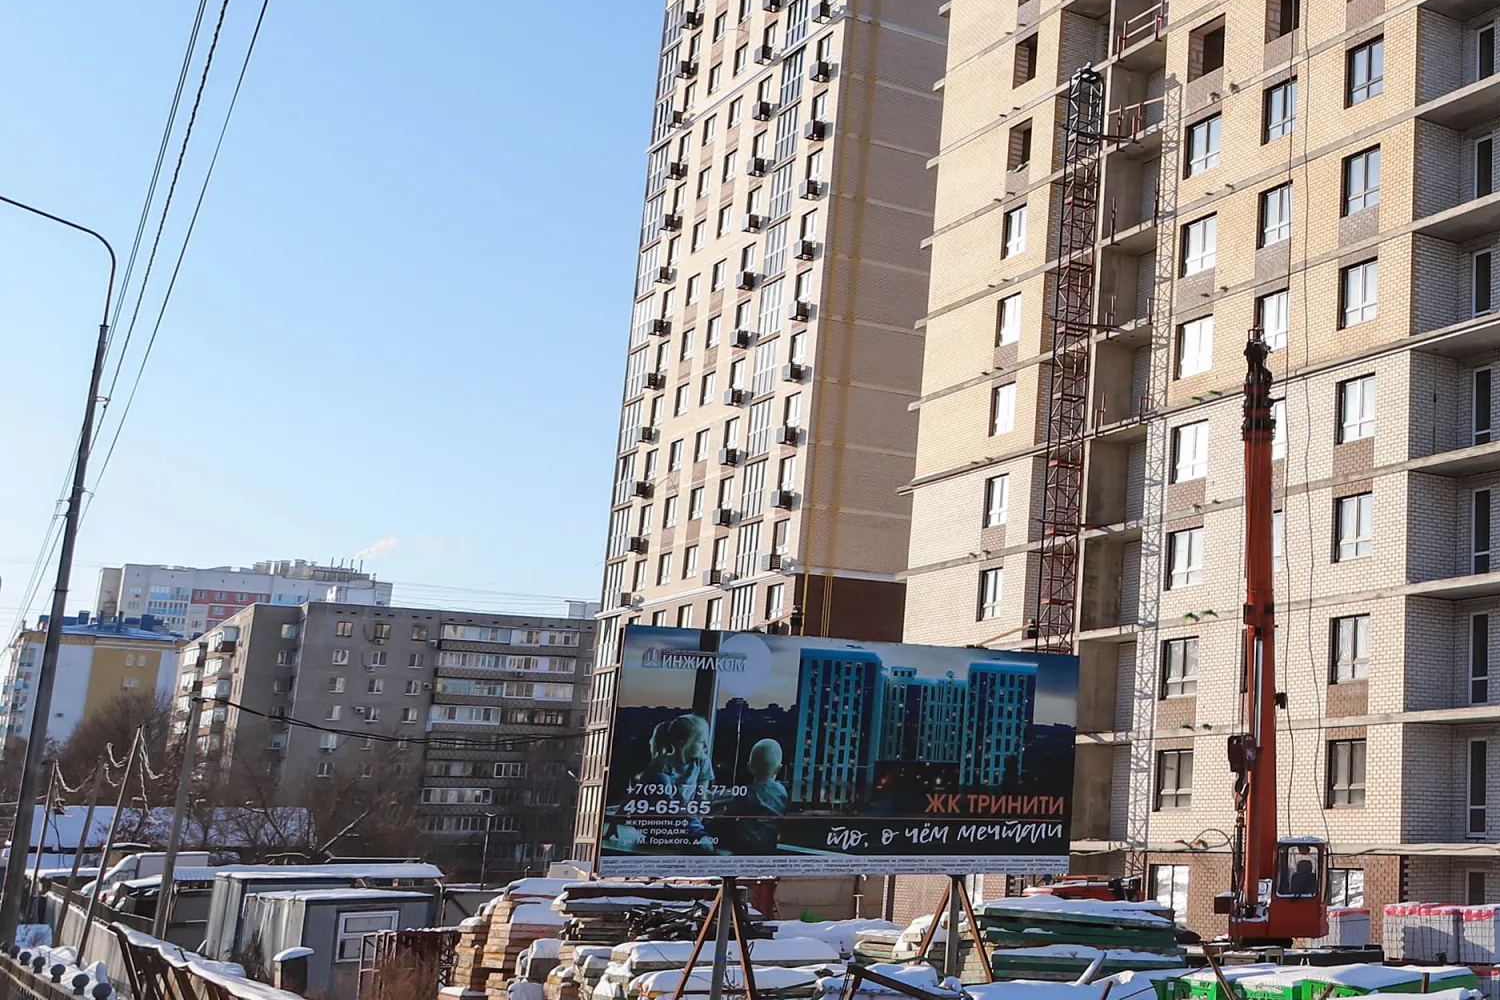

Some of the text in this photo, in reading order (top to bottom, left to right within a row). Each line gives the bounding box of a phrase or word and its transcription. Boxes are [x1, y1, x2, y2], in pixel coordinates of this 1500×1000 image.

[661, 654, 747, 673] ИНЖИЛКОМ
[626, 783, 677, 797] +7(930)
[623, 799, 711, 815] 49-65-65
[923, 793, 1065, 815] ЖК ТРИНИТИ
[624, 819, 689, 828] жктринити.рф
[881, 828, 899, 846] о
[904, 822, 949, 844] чём
[956, 819, 1063, 844] мечтали
[650, 837, 691, 846] Горького,
